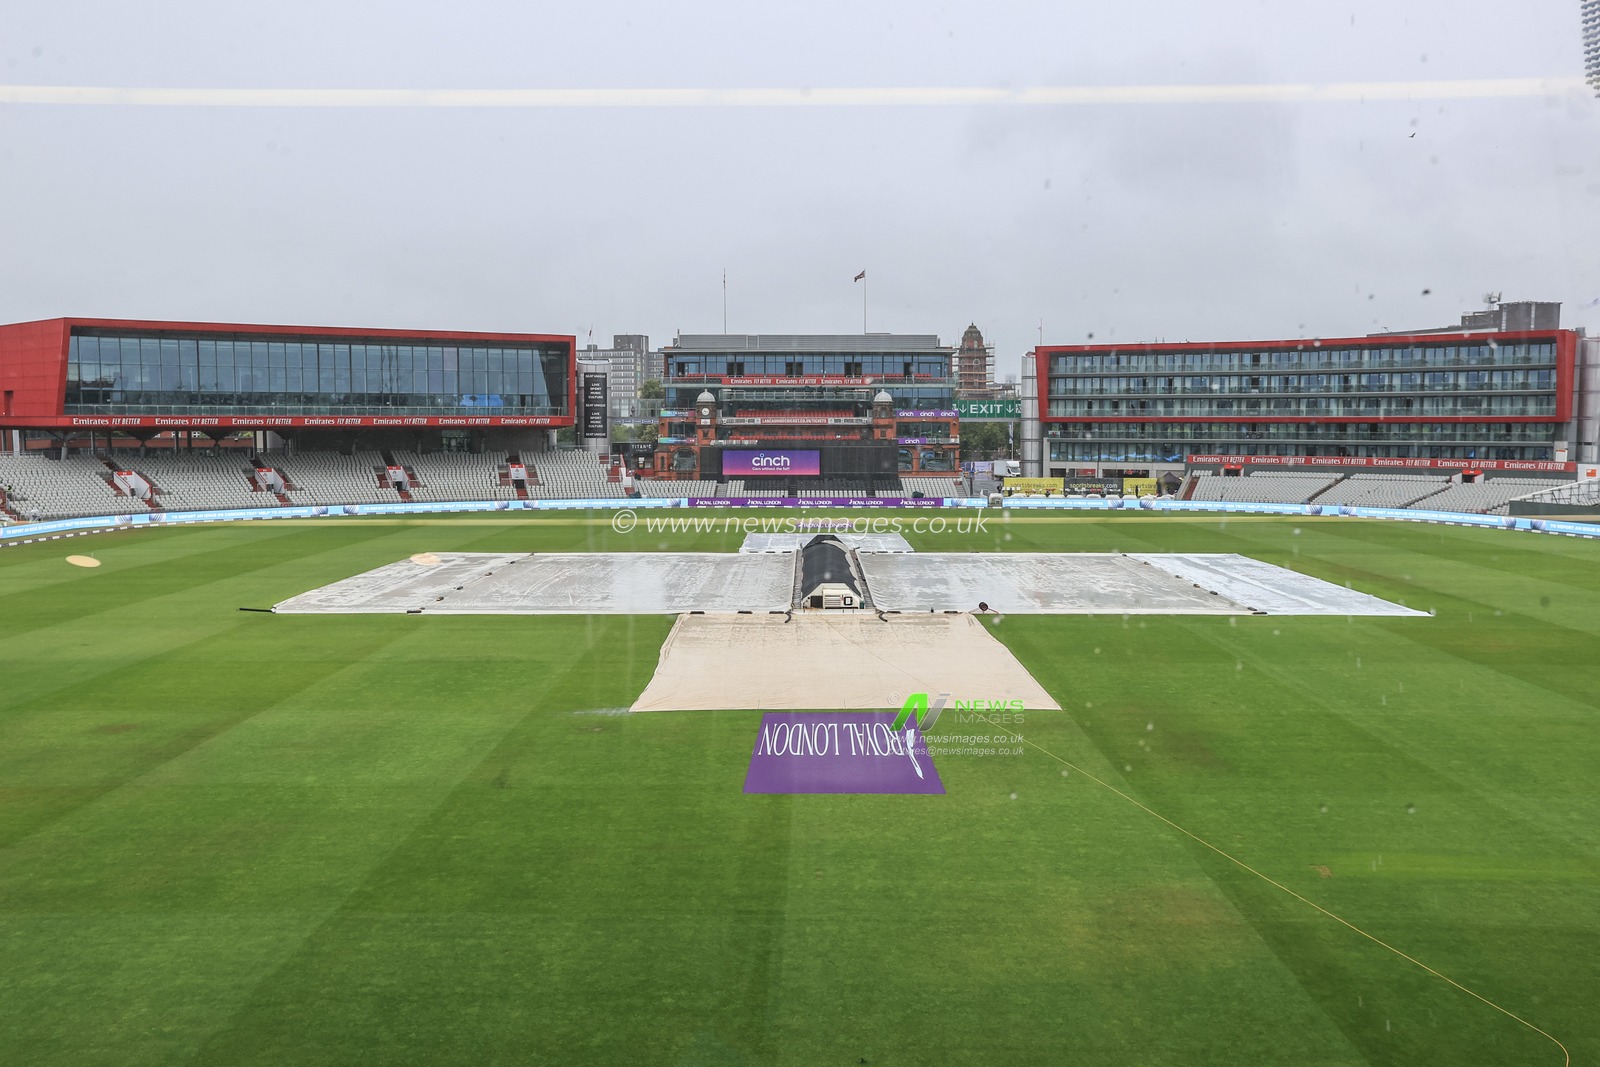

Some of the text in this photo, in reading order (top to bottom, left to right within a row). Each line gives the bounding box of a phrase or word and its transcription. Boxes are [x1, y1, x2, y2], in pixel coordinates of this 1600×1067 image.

[970, 404, 1003, 414] EXIT
[752, 453, 790, 466] cinch
[1504, 462, 1564, 470] Emirates FLY BETTER
[758, 722, 905, 756] ROYAL LONDON
